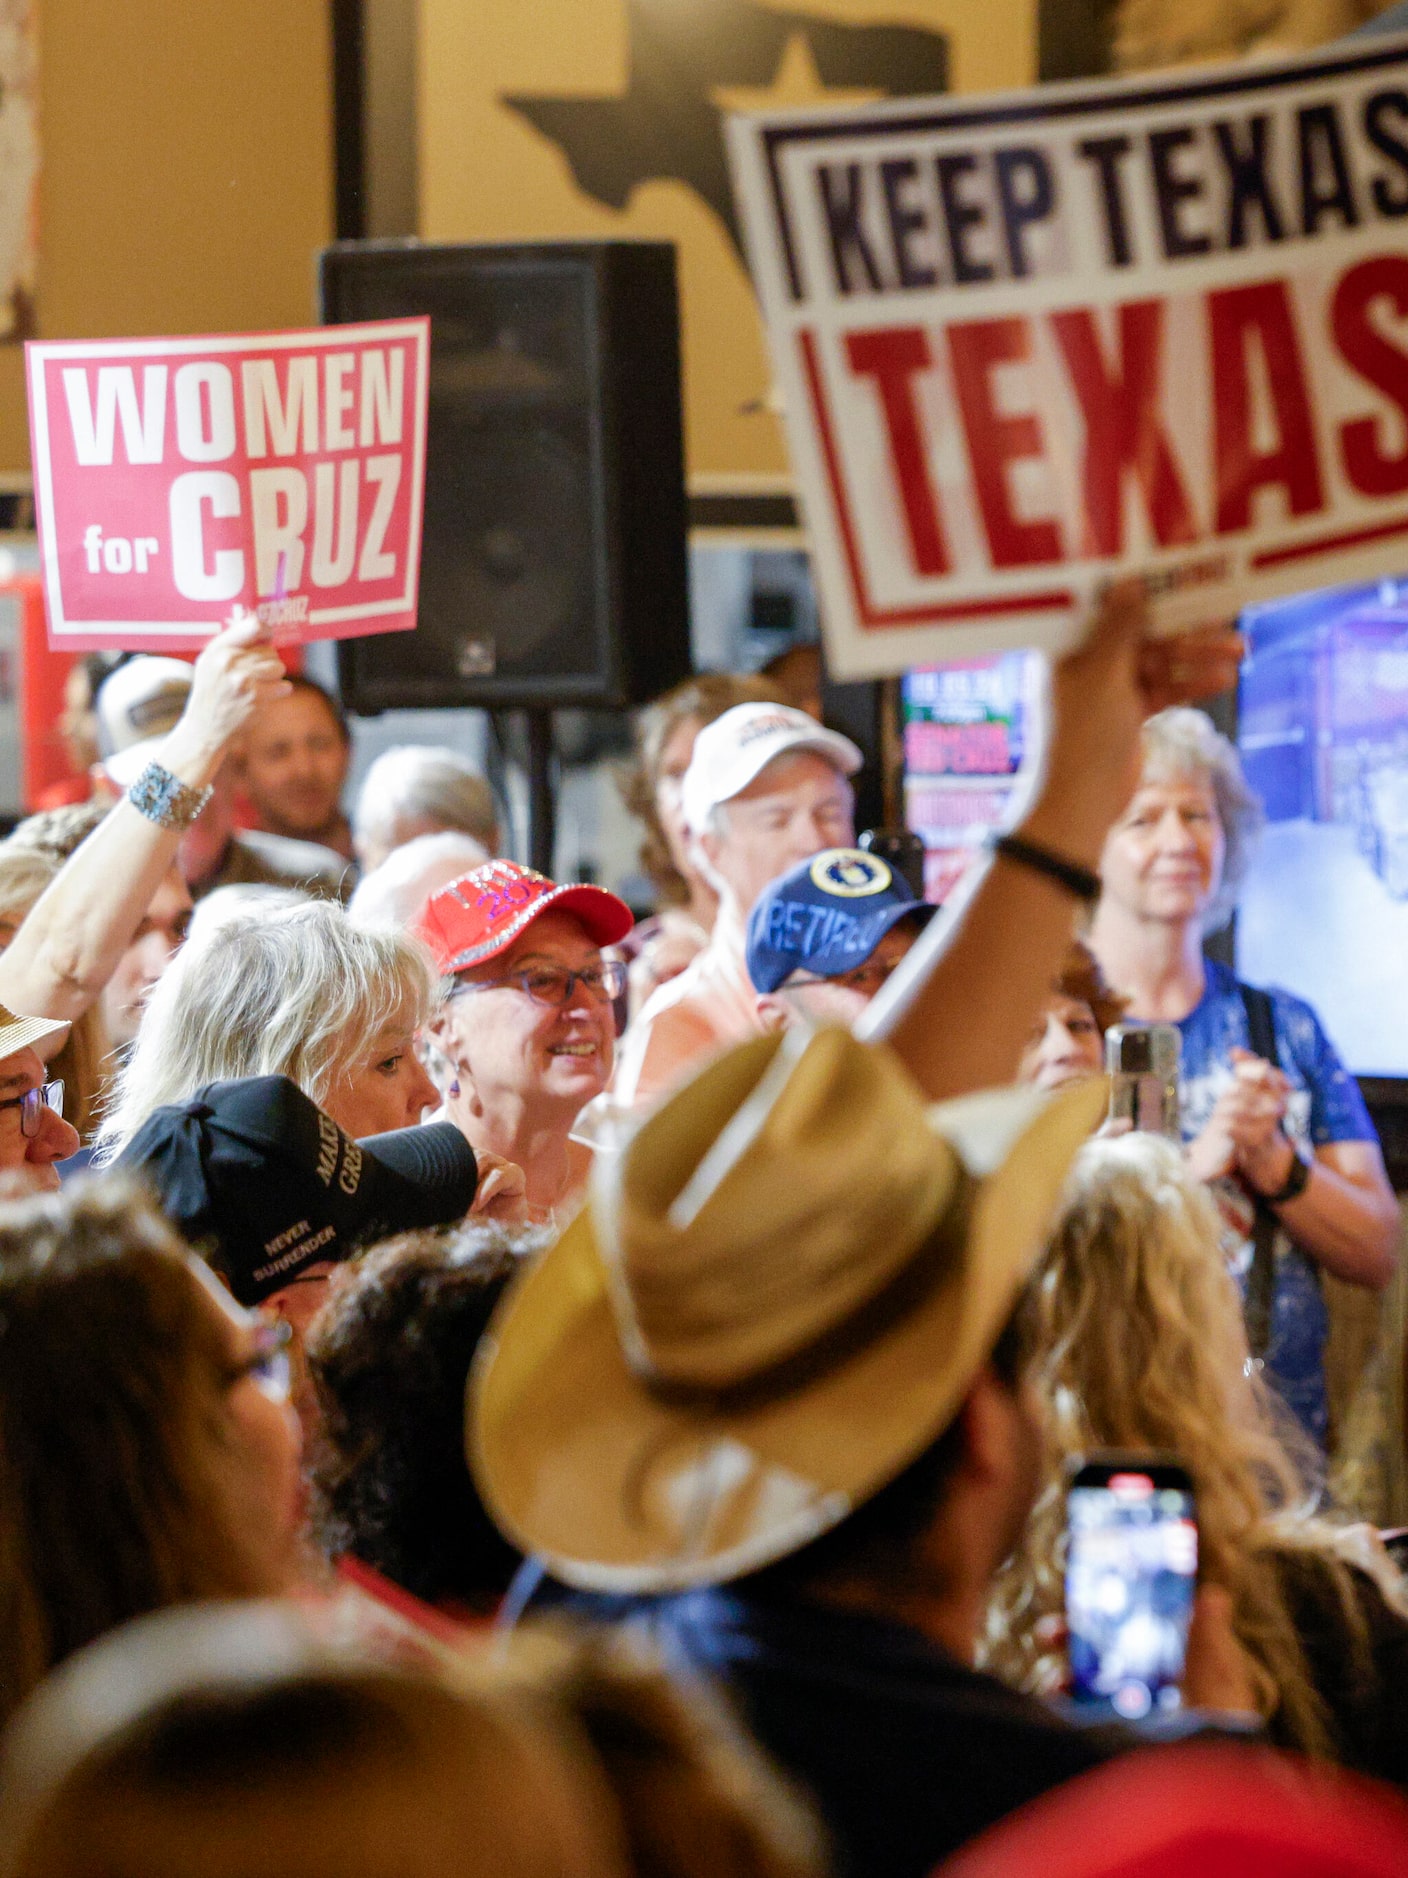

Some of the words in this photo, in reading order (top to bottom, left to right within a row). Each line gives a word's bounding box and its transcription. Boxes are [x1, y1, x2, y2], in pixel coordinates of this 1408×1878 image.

[816, 145, 1060, 296] KEEP
[62, 347, 405, 466] WOMEN
[82, 524, 159, 574] for
[168, 452, 403, 602] CRUZ
[264, 1219, 312, 1257] NEVER
